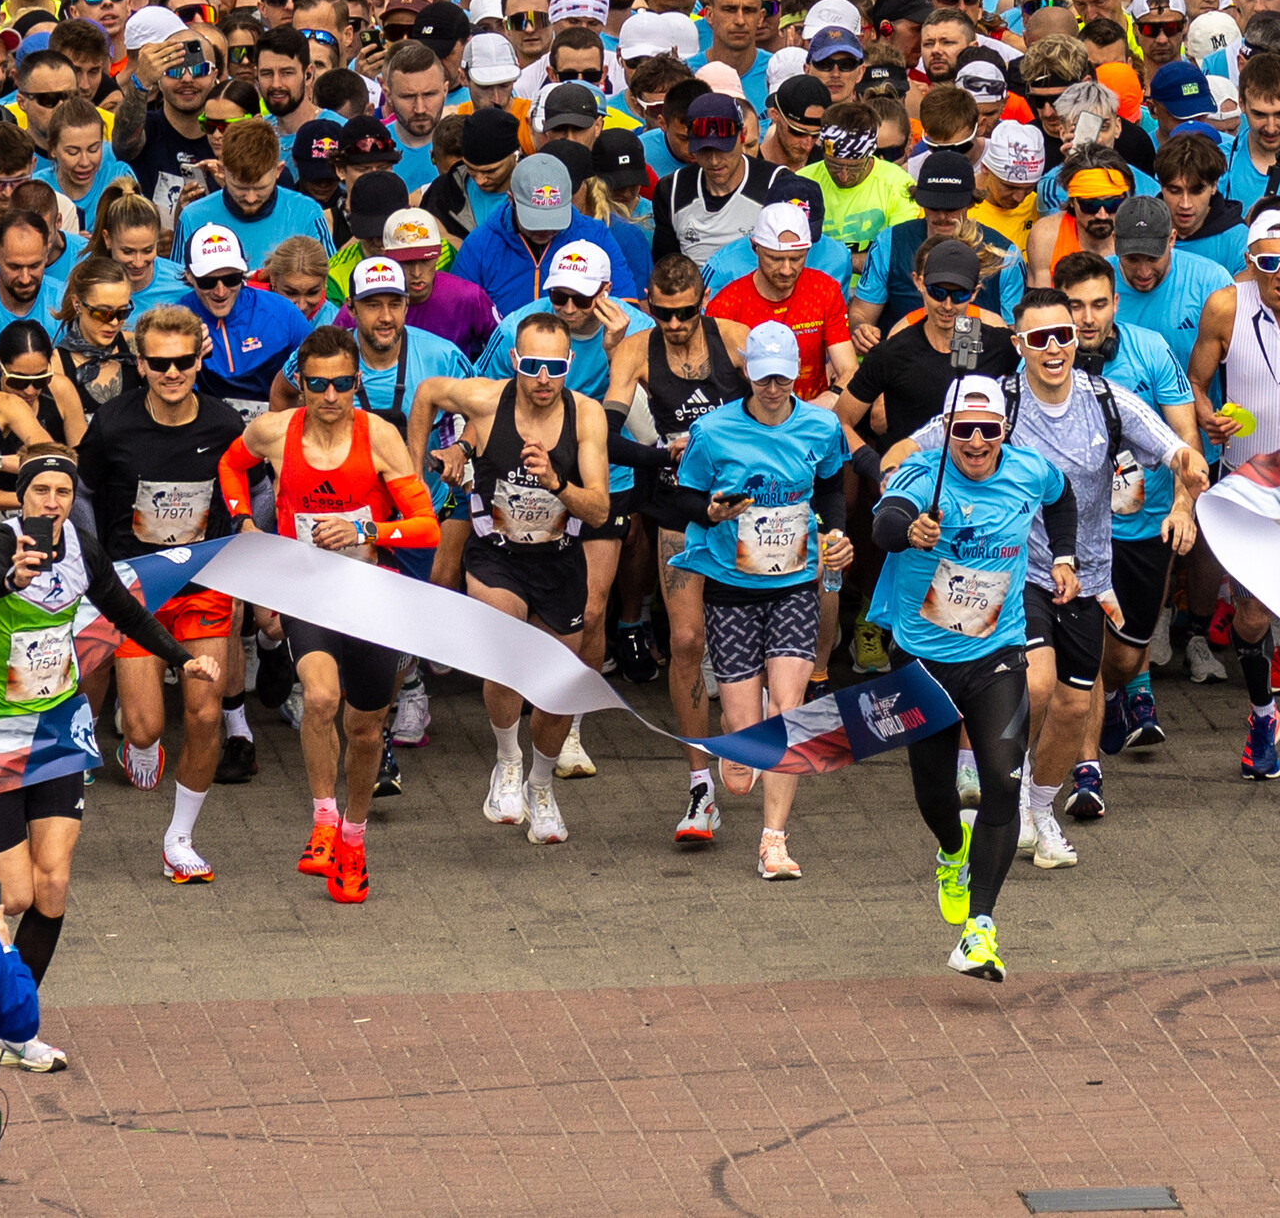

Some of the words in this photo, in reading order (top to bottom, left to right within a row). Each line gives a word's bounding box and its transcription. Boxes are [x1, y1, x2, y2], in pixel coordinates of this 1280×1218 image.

[927, 177, 962, 185] SALOMON
[202, 245, 217, 256] Red
[218, 244, 232, 253] Bull
[558, 263, 572, 271] Red
[572, 264, 588, 273] Bull
[366, 275, 380, 284] Red
[381, 275, 396, 283] Bull
[754, 491, 788, 507] WORLD
[154, 507, 193, 520] 17971
[510, 509, 550, 521] 17871
[757, 532, 796, 547] 14437
[961, 544, 1000, 560] WORLD
[999, 545, 1020, 558] RUN
[946, 590, 989, 611] 18179
[874, 714, 906, 738] WORLD
[898, 707, 927, 731] RUN
